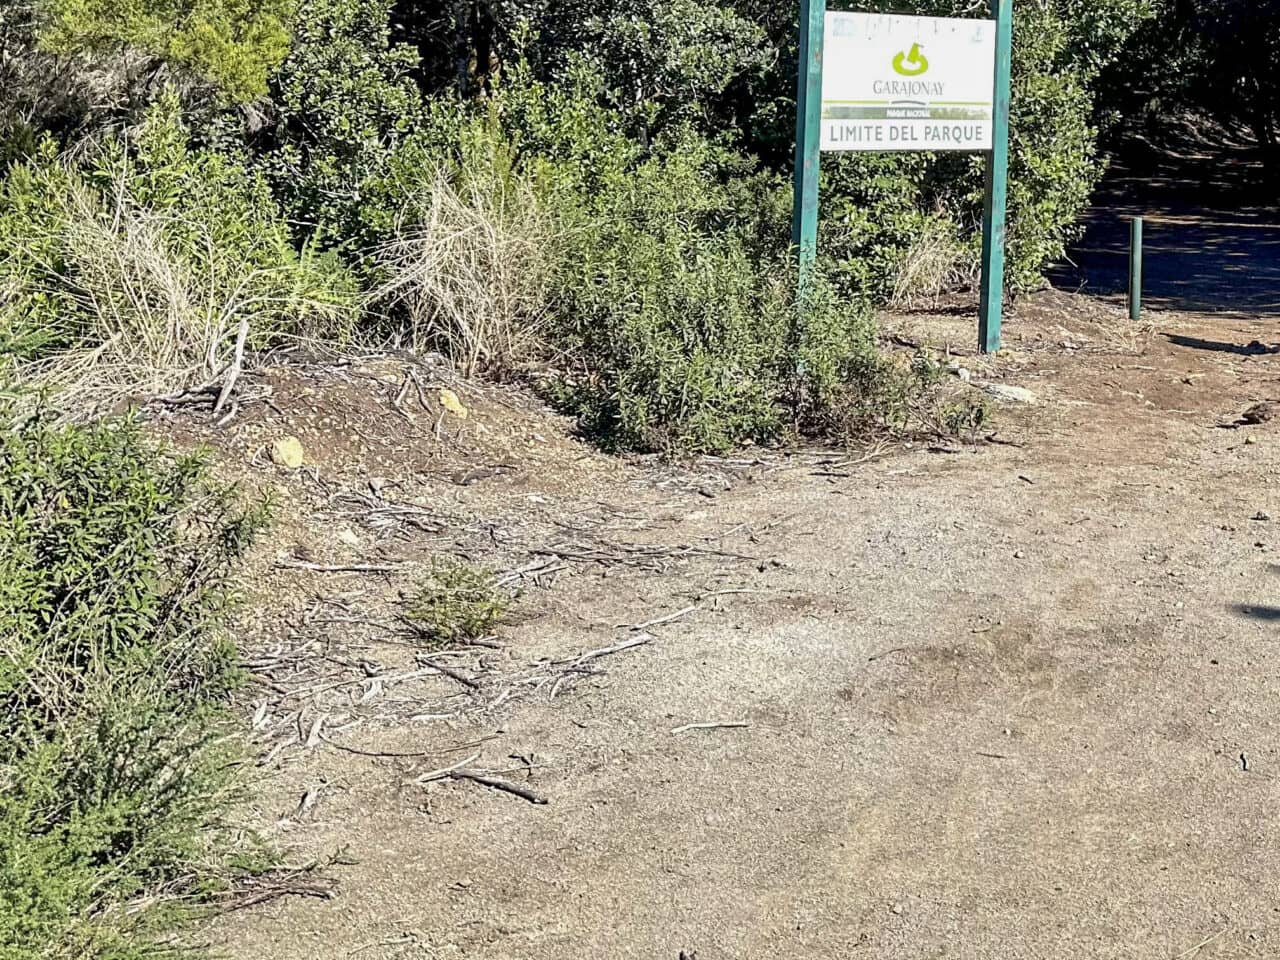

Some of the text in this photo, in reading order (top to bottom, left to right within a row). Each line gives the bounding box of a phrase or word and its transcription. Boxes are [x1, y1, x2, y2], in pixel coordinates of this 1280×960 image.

[872, 79, 945, 96] GARAJONAY
[830, 125, 983, 143] LIMITE DEL PARQUE
